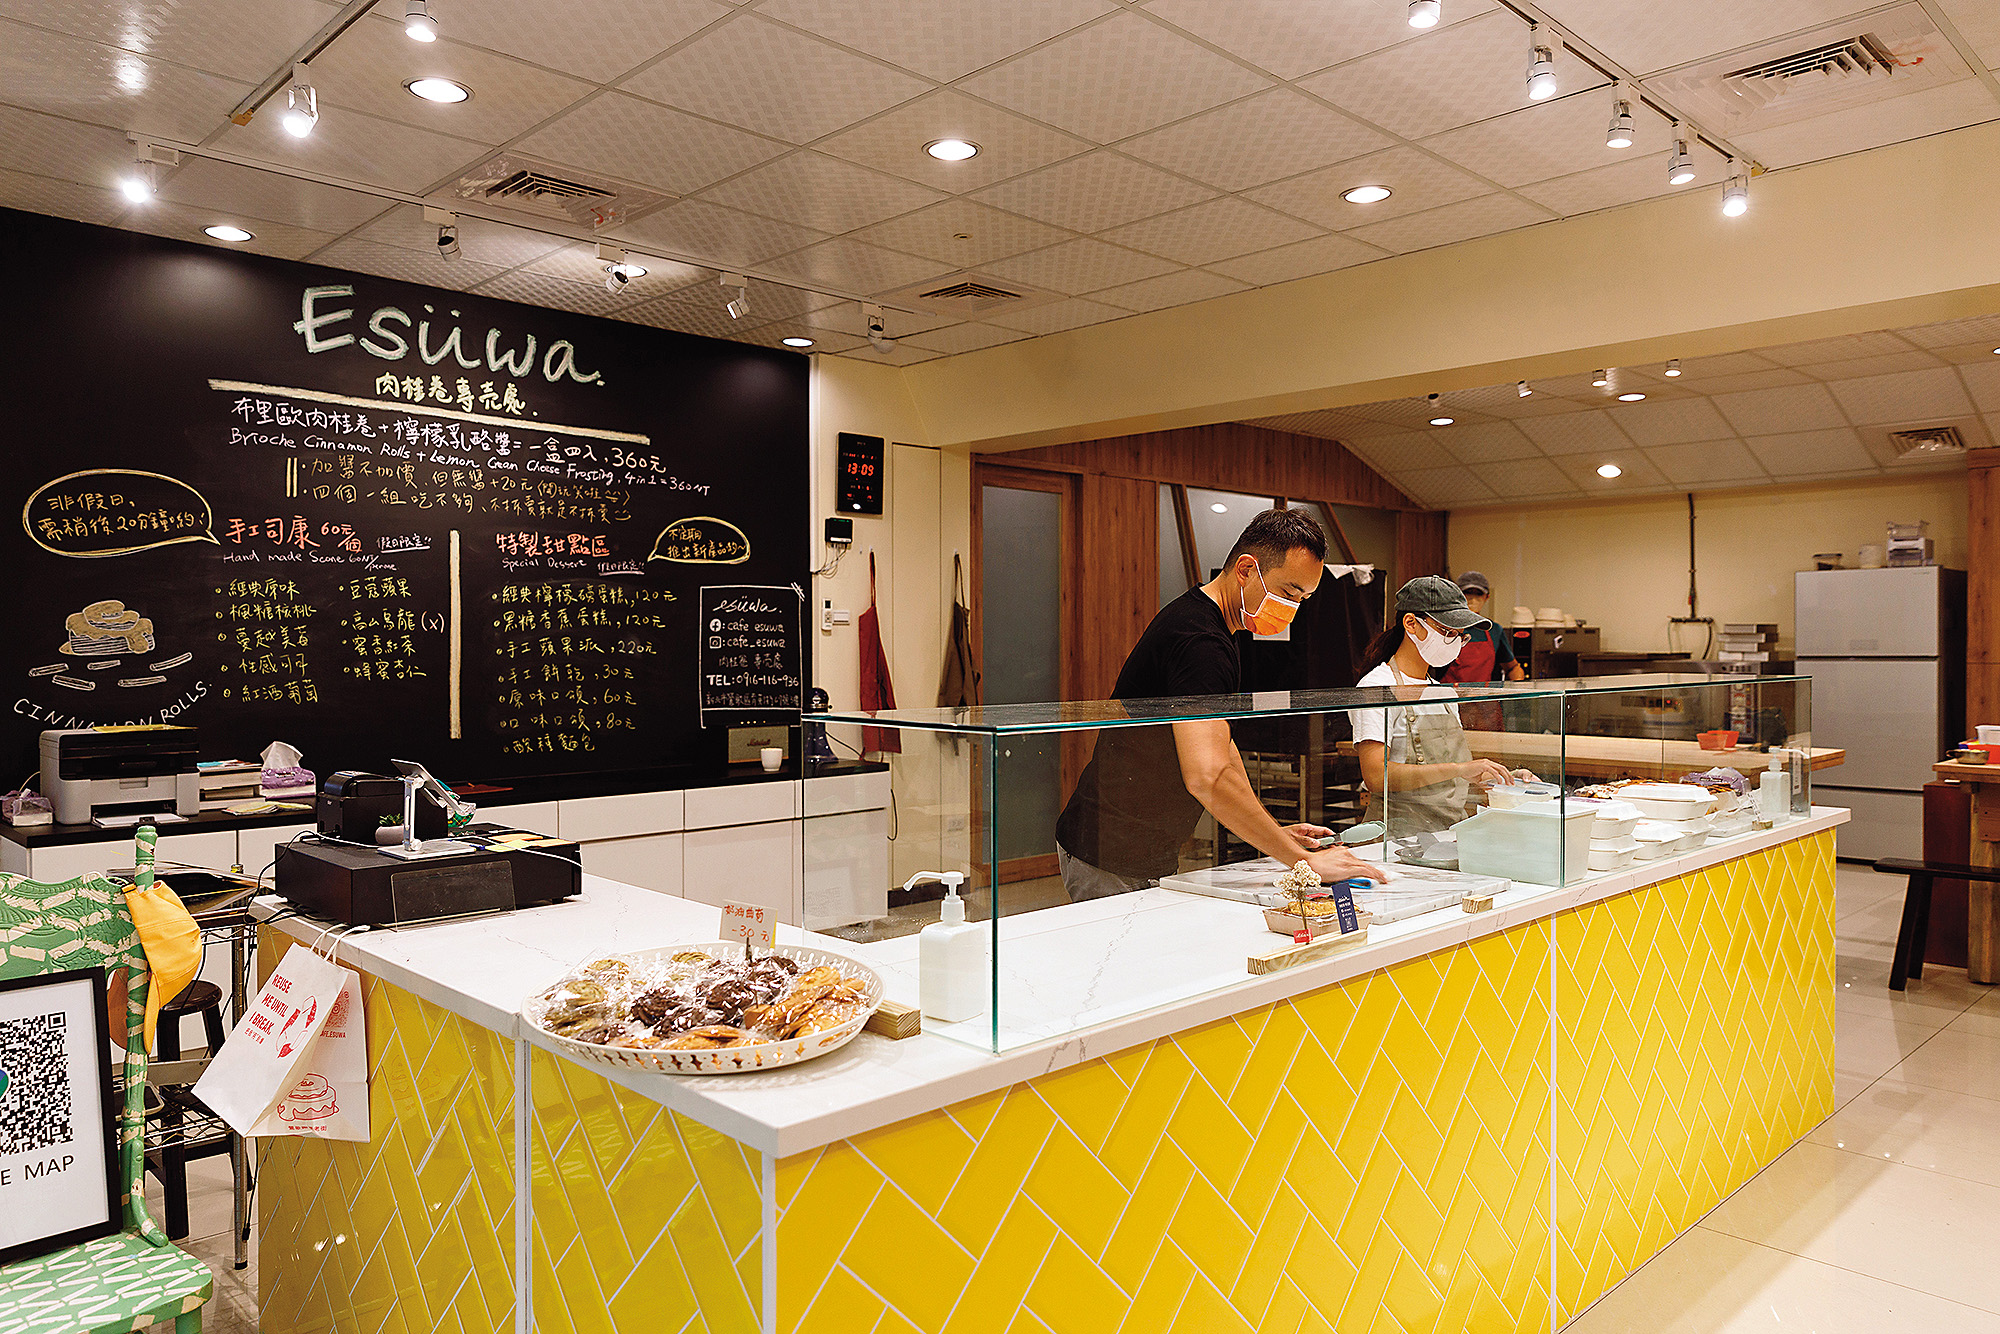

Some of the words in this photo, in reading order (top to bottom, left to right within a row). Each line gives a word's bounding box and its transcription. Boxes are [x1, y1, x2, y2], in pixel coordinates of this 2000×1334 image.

[229, 428, 297, 448] Brioche
[303, 434, 373, 454] Cinnamon
[380, 443, 411, 460] Rolls
[430, 449, 480, 469] Lemon
[526, 459, 560, 475] Cheese
[847, 462, 874, 476] 13:09
[225, 515, 320, 550] 手工司康
[496, 531, 610, 558] 特製甜點區
[223, 550, 260, 564] Hand
[268, 551, 303, 562] made
[502, 557, 540, 573] Special
[228, 578, 300, 601] 經典原味
[230, 600, 317, 622] 楓糖核桃
[352, 634, 417, 656] 蜜香紅茶
[354, 658, 427, 680] 蜂蜜杏仁
[242, 679, 318, 704] 紅酒葡萄
[271, 973, 293, 994] REUSE
[261, 993, 275, 1007] ME
[270, 997, 289, 1018] UNTIL
[24, 1154, 75, 1181] MAP
